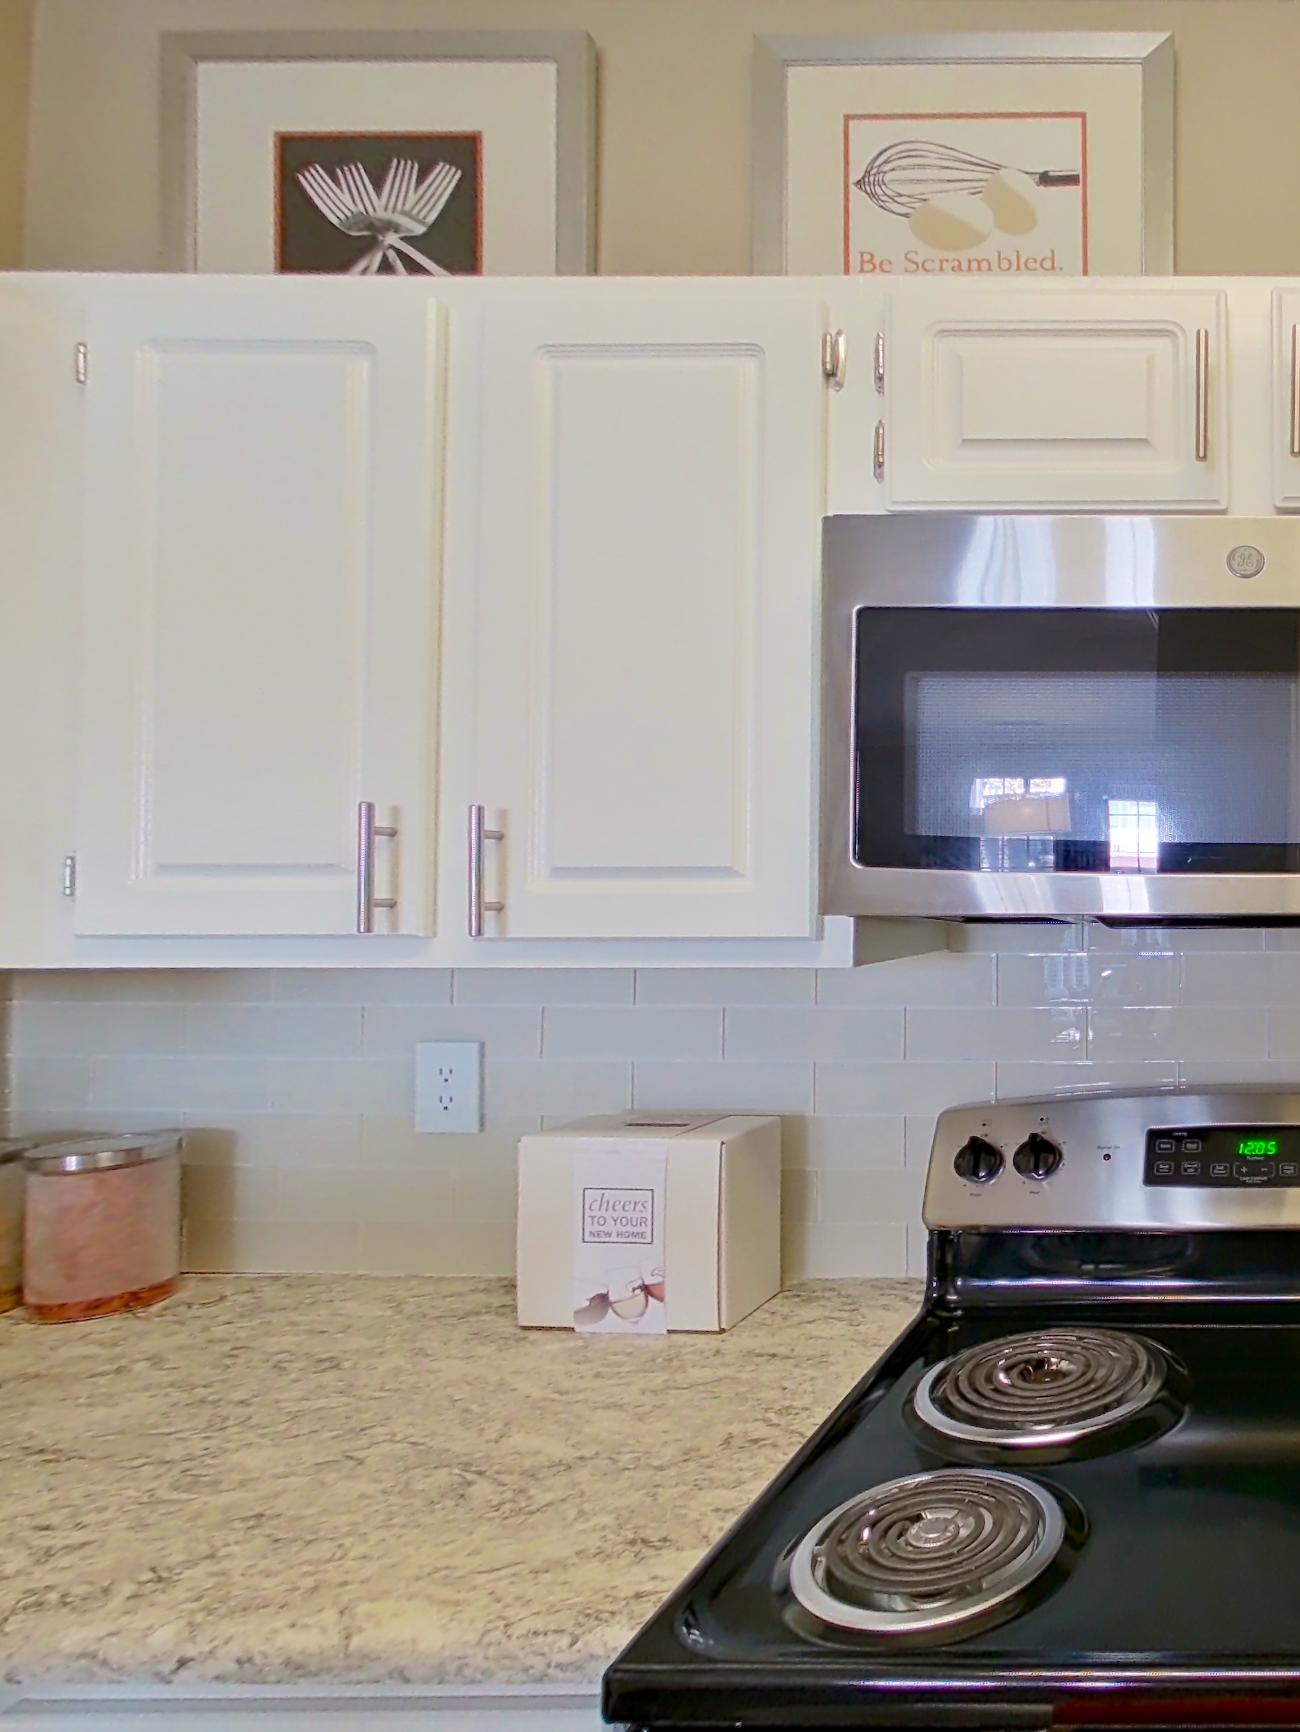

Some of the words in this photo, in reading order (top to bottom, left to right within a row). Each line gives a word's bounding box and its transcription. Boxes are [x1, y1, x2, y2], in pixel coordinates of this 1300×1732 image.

[858, 251, 893, 274] Be
[903, 248, 1064, 273] Scrambled.
[1238, 1141, 1277, 1155] 12:05
[588, 1192, 649, 1213] cheers
[588, 1215, 607, 1227] TO
[611, 1216, 649, 1228] YOUR
[588, 1230, 613, 1239] NEW
[616, 1231, 647, 1240] HOME
